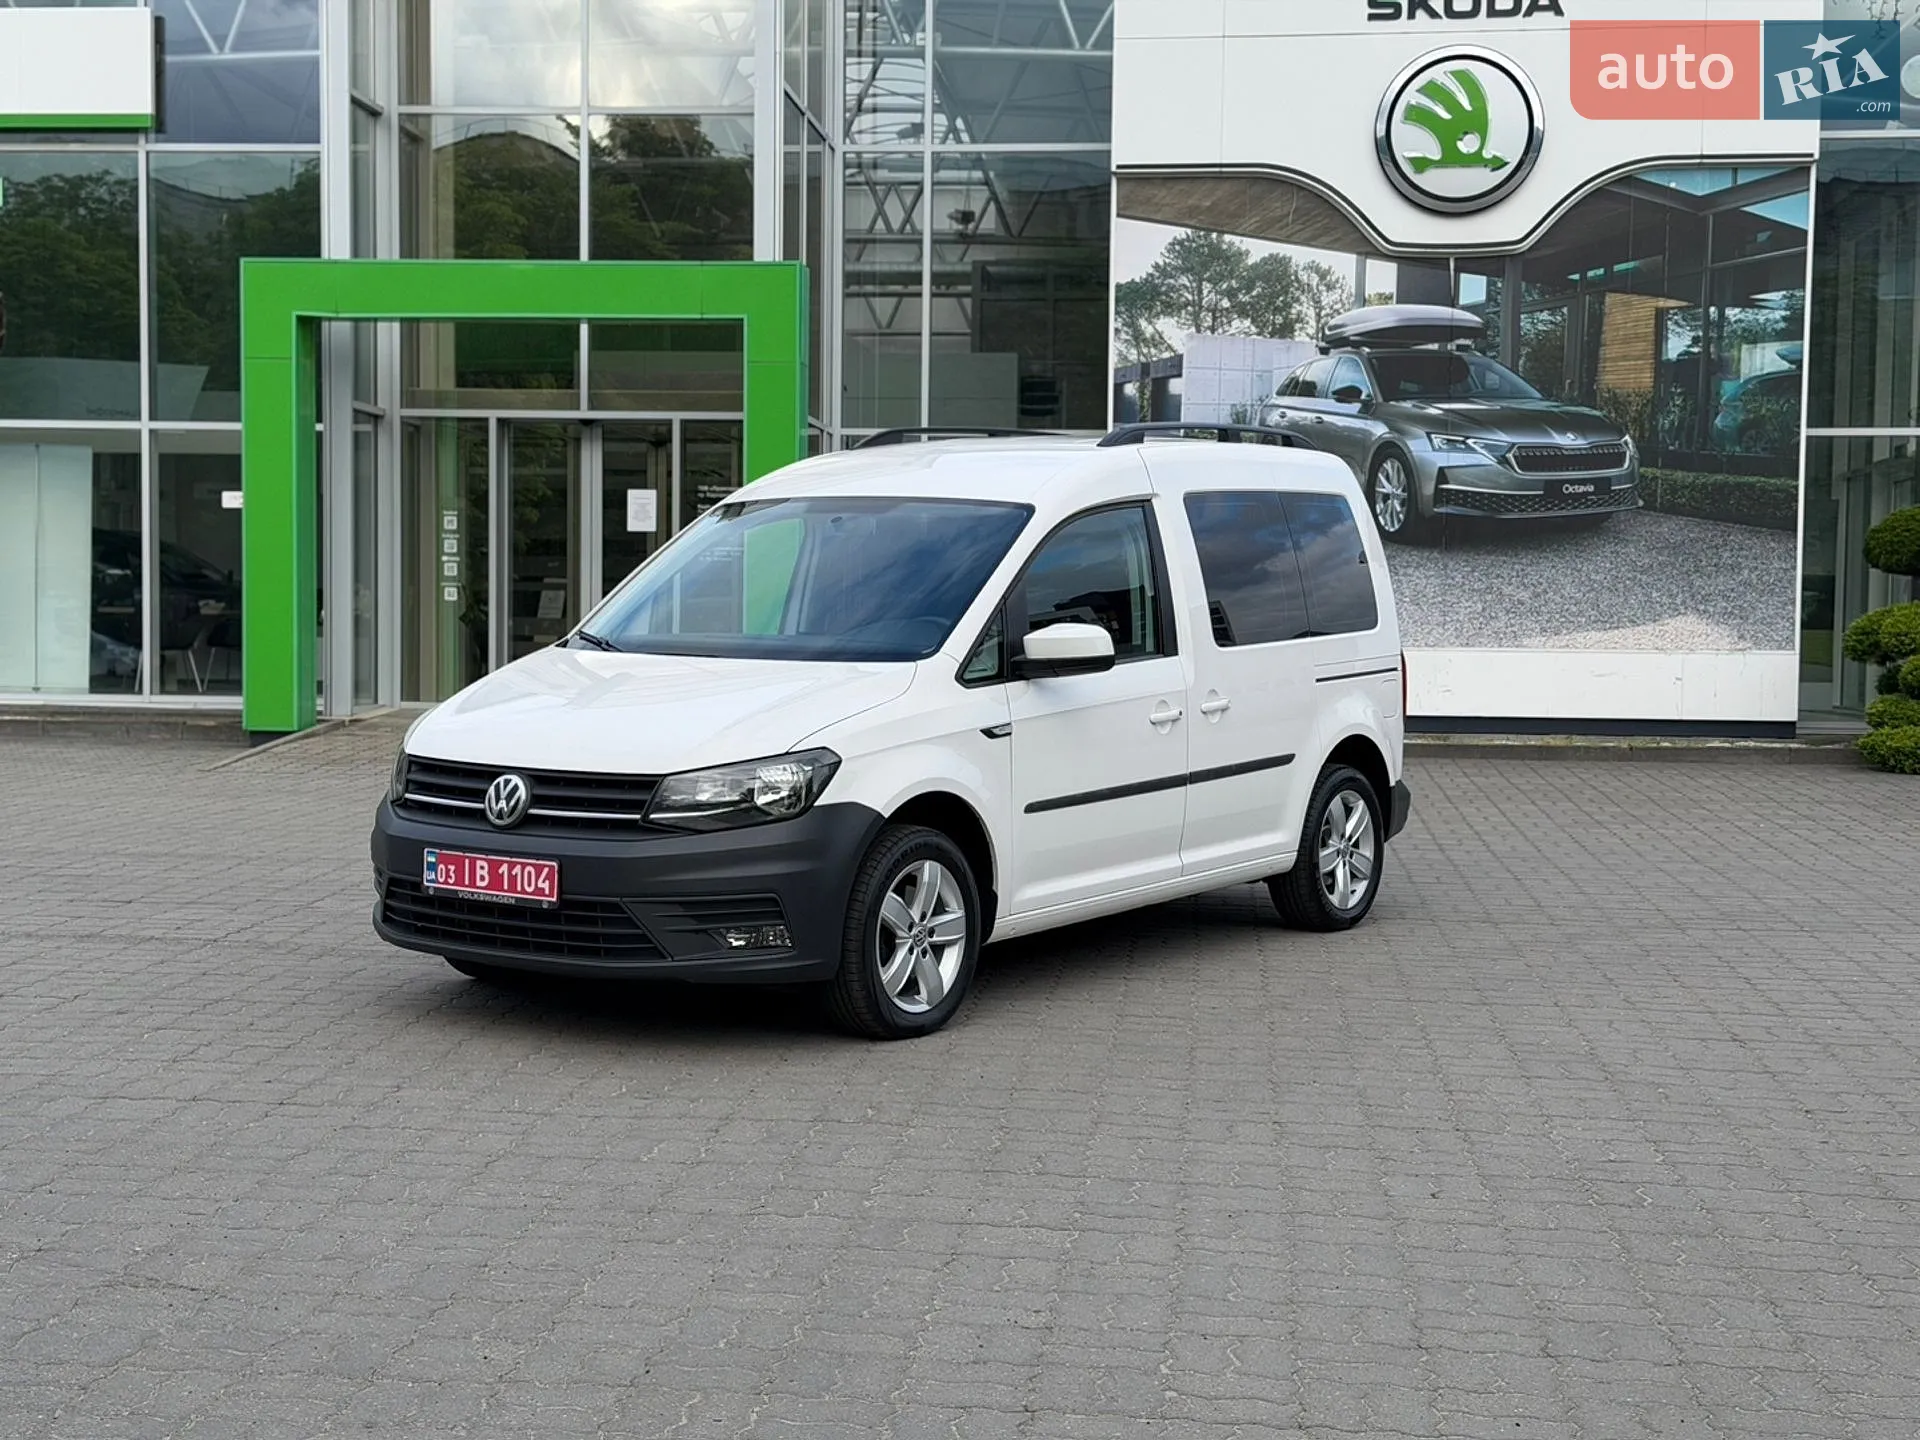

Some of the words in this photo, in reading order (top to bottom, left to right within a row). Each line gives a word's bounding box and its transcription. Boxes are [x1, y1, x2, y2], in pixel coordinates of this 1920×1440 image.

[1562, 483, 1595, 494] Octavia
[426, 871, 436, 880] UA
[437, 864, 456, 884] 03
[464, 858, 489, 887] IB
[498, 863, 550, 895] 1104
[458, 890, 516, 904] VOLKSWAGEN
